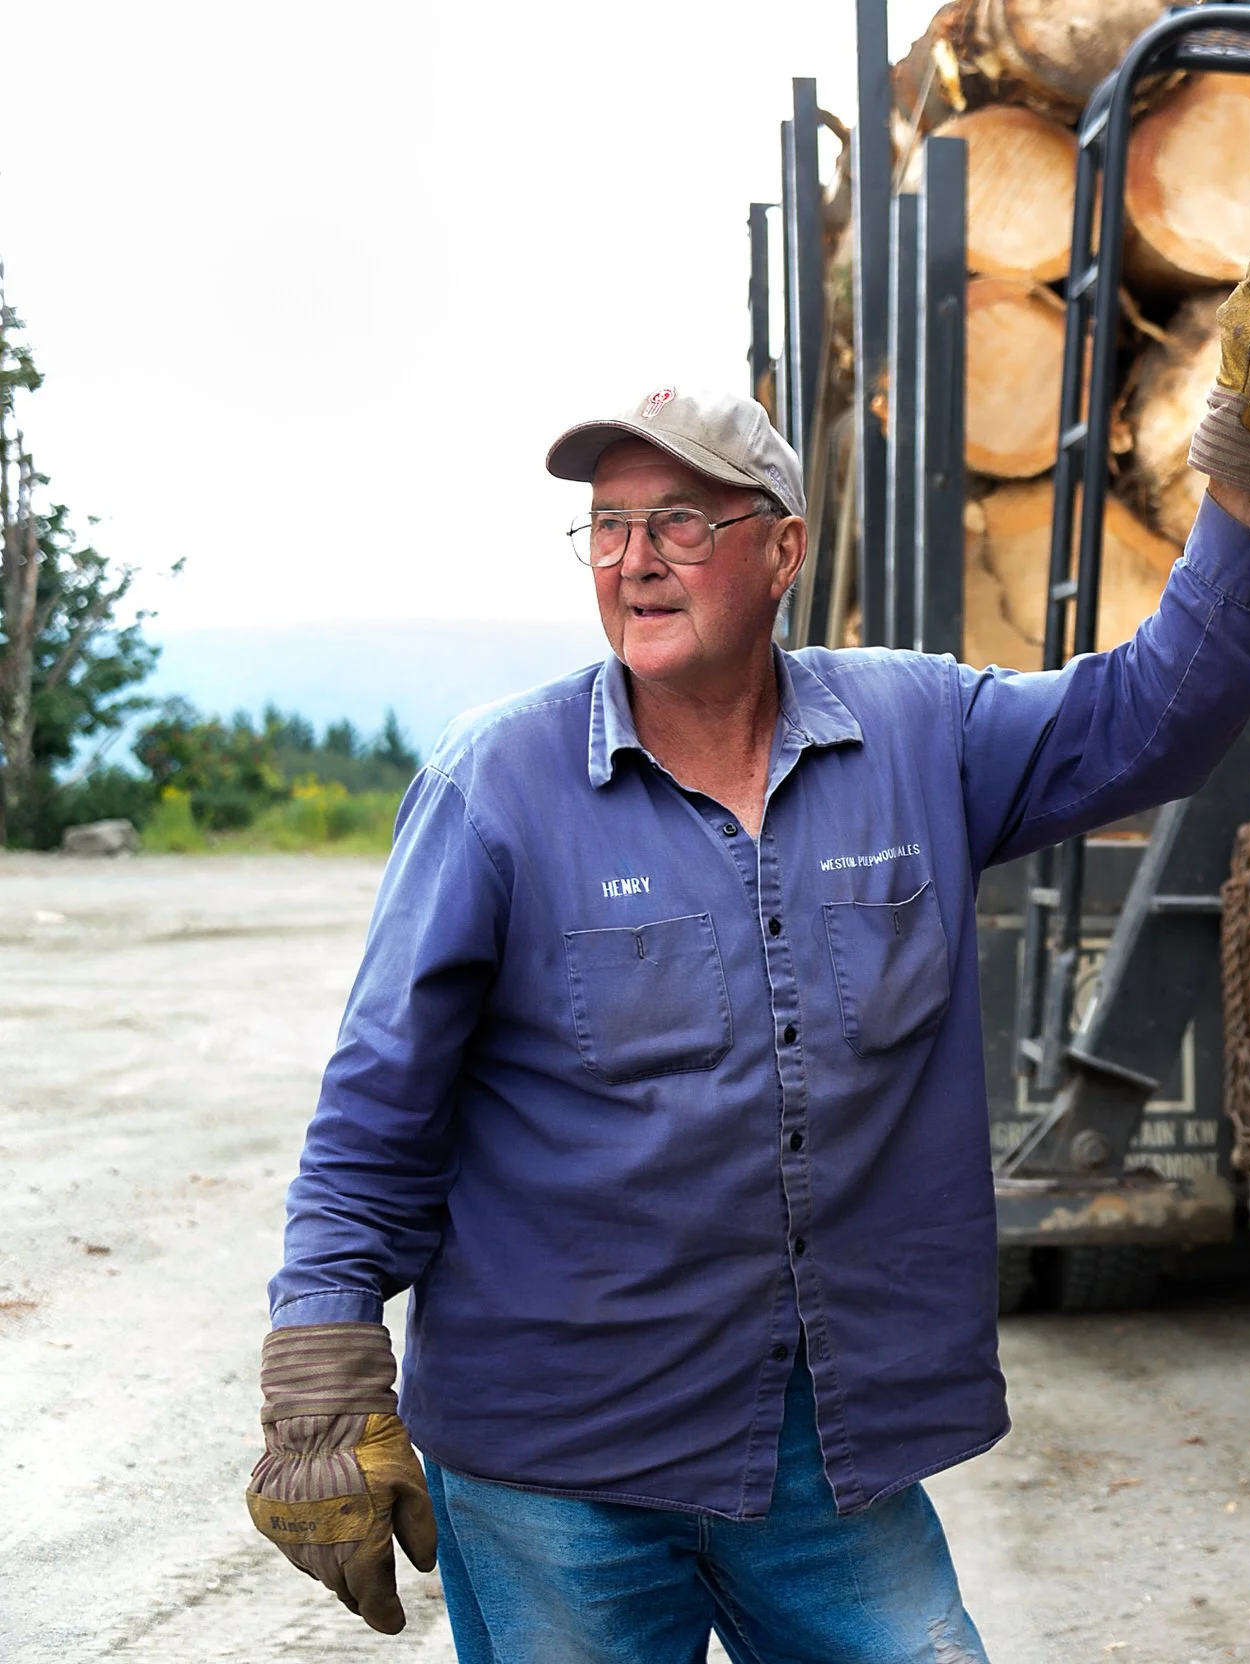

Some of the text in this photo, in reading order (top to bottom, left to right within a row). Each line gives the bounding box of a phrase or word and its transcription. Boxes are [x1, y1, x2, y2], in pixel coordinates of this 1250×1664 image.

[897, 843, 921, 858] ALES
[601, 876, 650, 898] HENRY
[269, 1515, 317, 1533] Kinco
